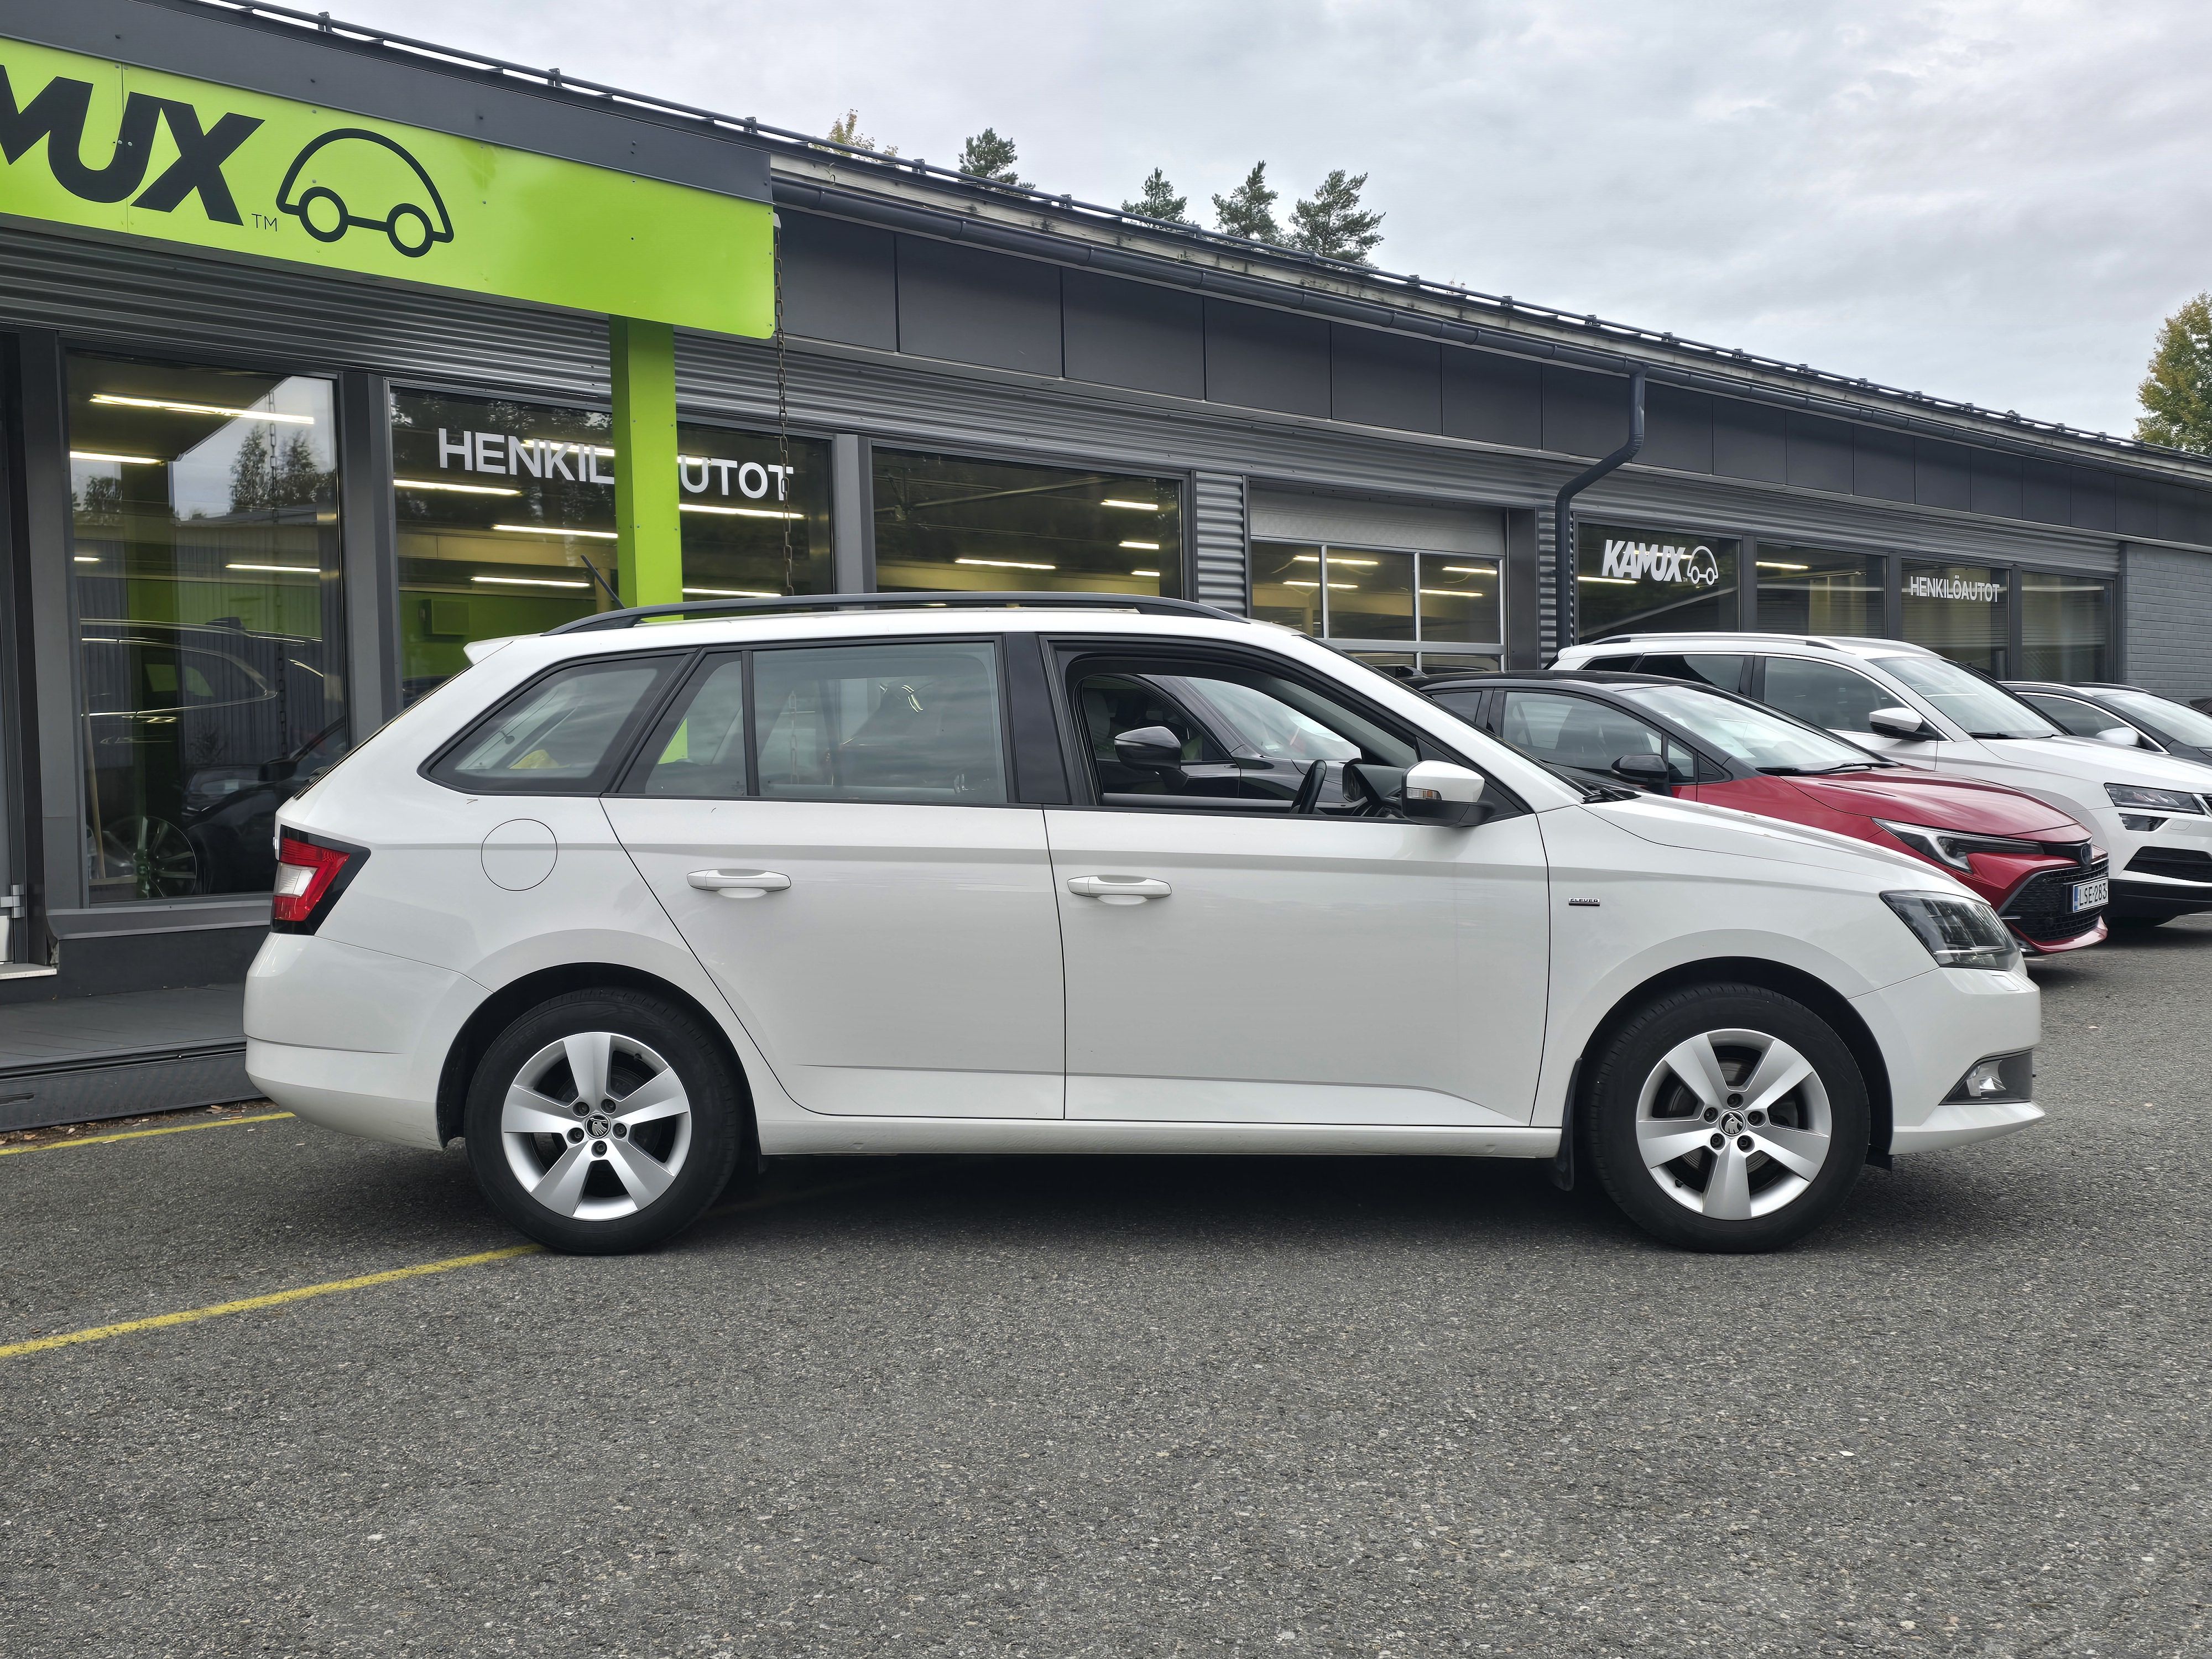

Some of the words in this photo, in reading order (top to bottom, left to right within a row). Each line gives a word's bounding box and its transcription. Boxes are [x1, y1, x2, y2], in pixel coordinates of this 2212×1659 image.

[251, 213, 277, 232] TM
[439, 427, 794, 501] HENKILUTOT
[1601, 539, 1686, 582] KAMUX
[1911, 575, 2000, 602] HENKILÖAUTOT
[2079, 883, 2107, 906] LSE-283
